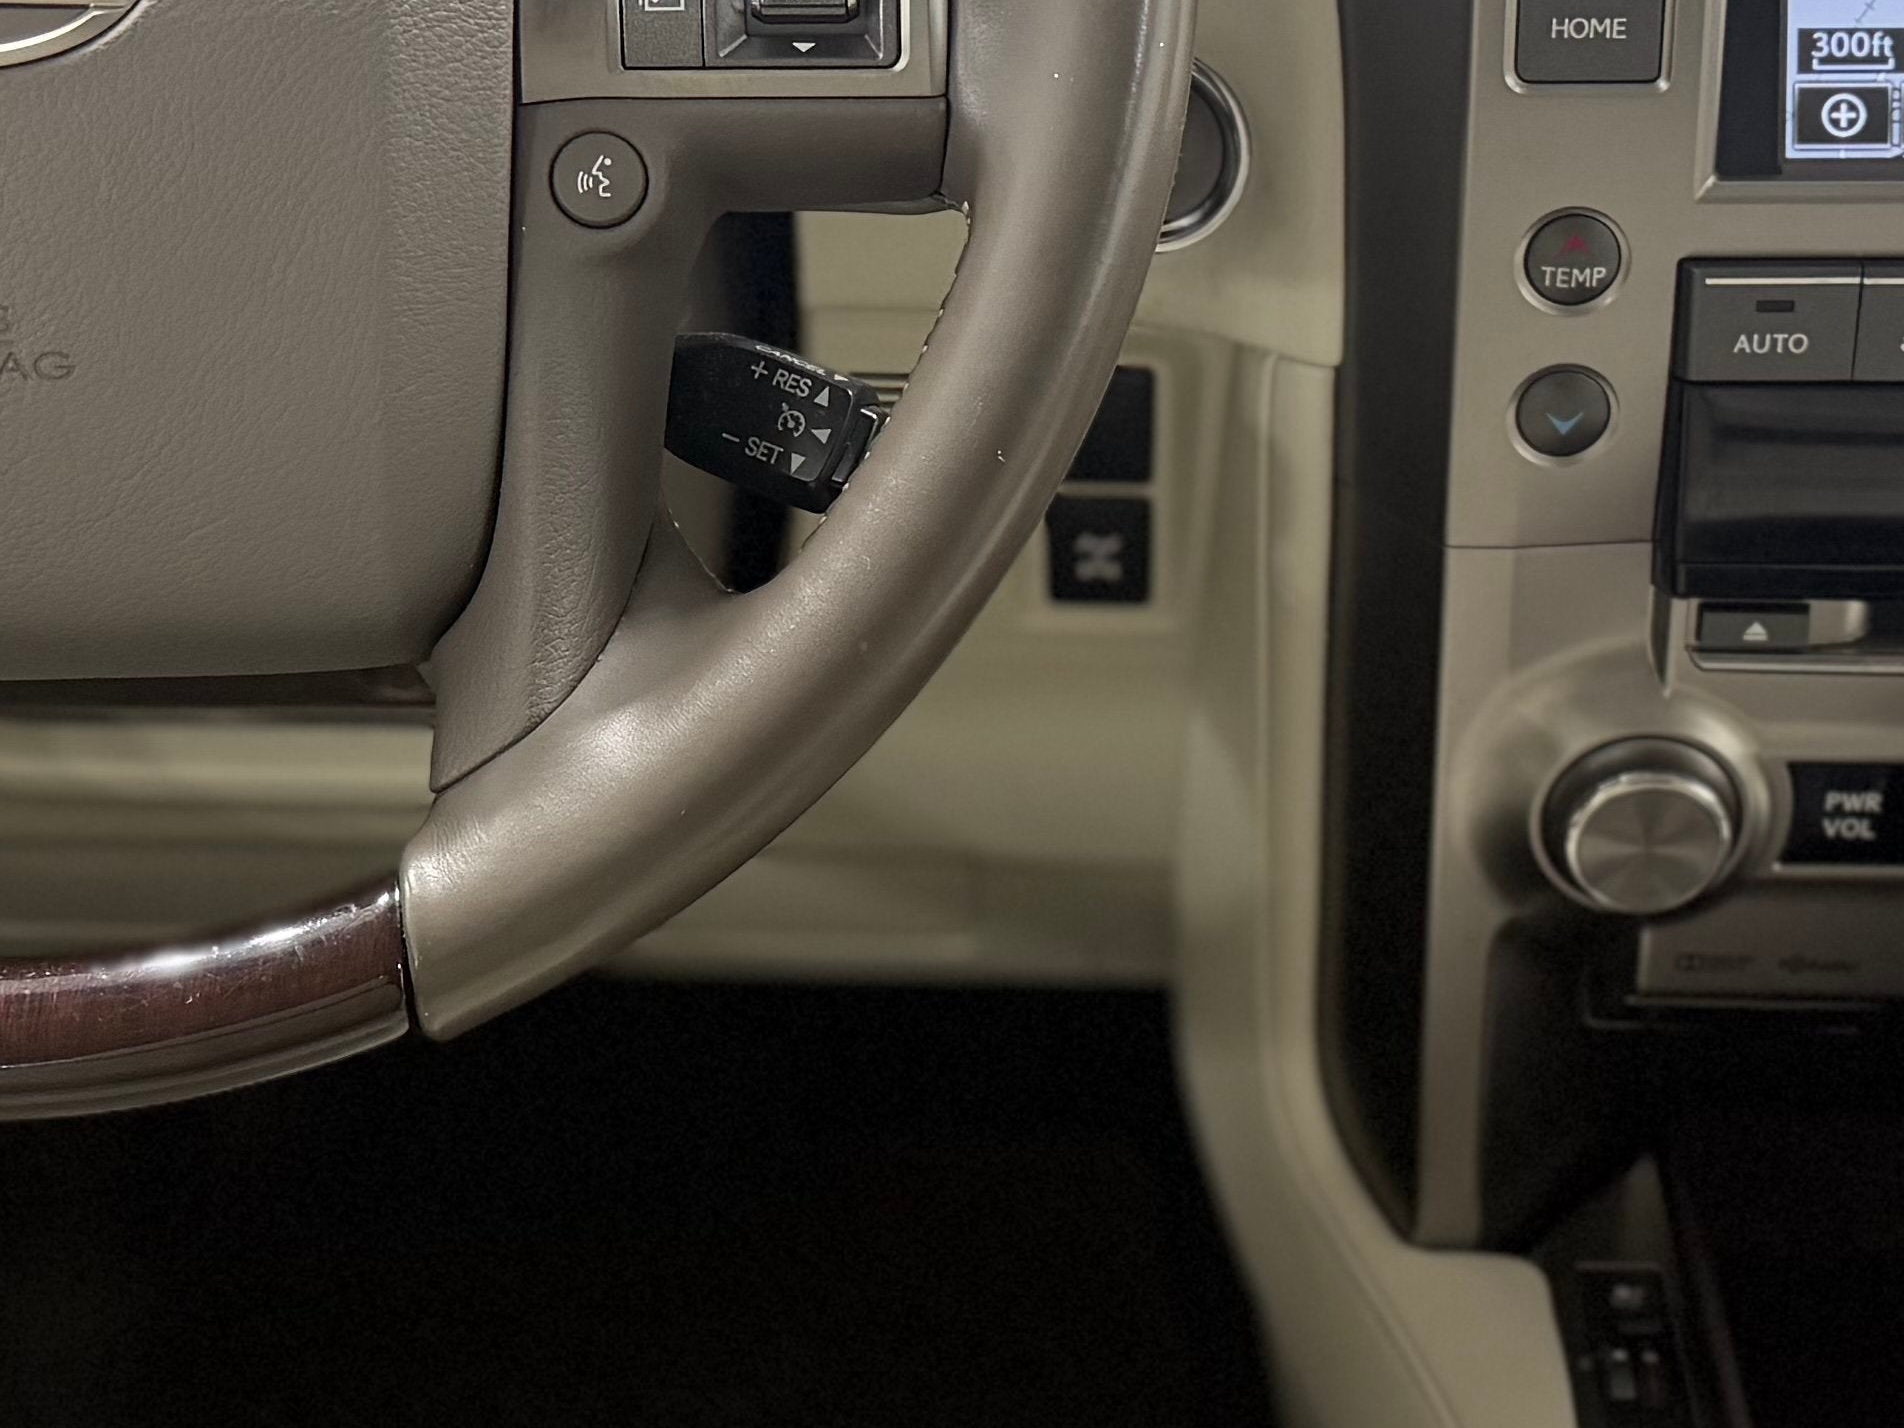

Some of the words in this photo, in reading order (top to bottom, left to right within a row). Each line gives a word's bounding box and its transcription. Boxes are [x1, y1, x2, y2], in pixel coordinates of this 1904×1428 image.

[1551, 18, 1627, 40] HOME
[1812, 32, 1894, 59] 300ft
[1541, 265, 1607, 288] TEMP
[1733, 333, 1808, 354] AUTO
[772, 368, 812, 398] RES
[745, 437, 784, 465] SET
[1824, 791, 1883, 813] PWR
[1822, 818, 1876, 840] VOL
